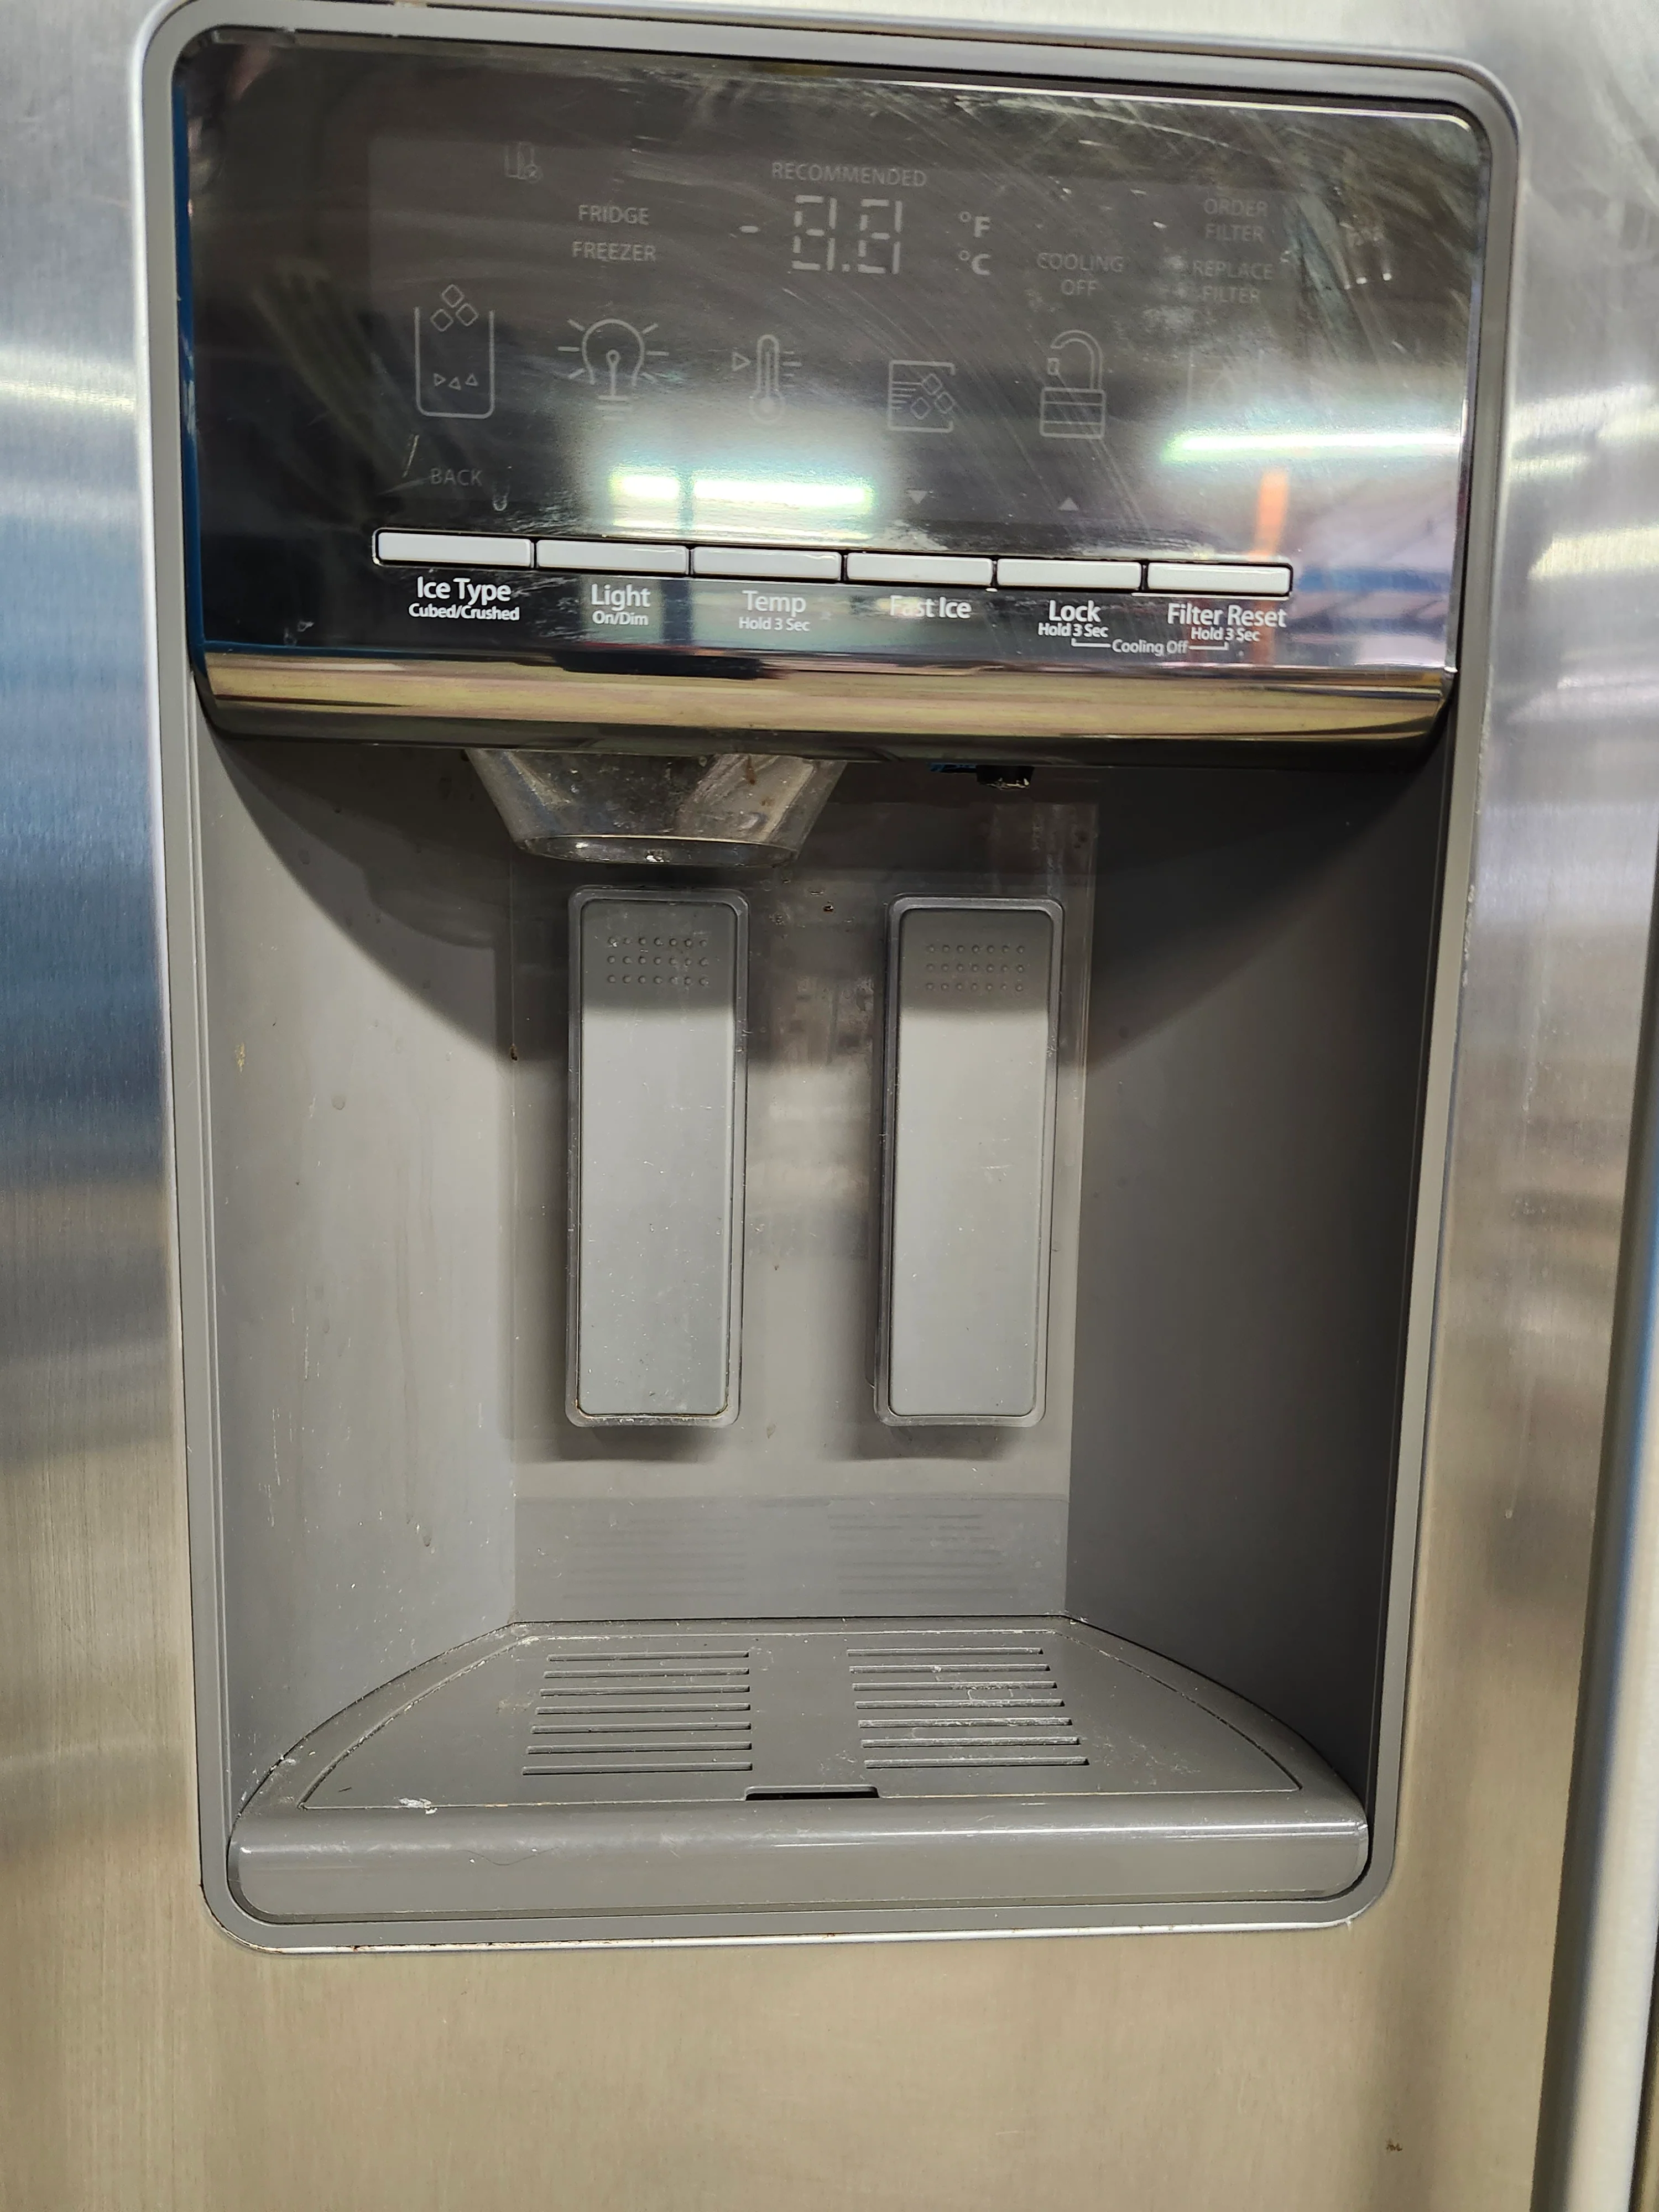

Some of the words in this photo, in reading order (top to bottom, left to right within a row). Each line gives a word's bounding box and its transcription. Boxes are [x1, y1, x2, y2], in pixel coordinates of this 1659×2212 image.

[771, 161, 928, 187] RECOMMENDED
[578, 205, 650, 225] FRIDGE
[1203, 197, 1269, 217] ORDER
[1206, 225, 1264, 242] FILTER
[572, 241, 657, 262] FREEZER
[1036, 253, 1125, 272] COOLING
[1193, 261, 1273, 279] REPLACE
[1061, 280, 1098, 296] OFF
[1203, 287, 1261, 304] FILTER
[430, 468, 482, 486] BACK
[417, 577, 450, 599] Ice
[453, 578, 512, 606] Type
[591, 584, 650, 609] Light
[408, 603, 520, 622] Cubed/Crushed
[742, 590, 806, 616] Temp
[890, 596, 937, 618] Fast
[939, 597, 972, 619] Ice
[1048, 601, 1100, 623] Lock
[592, 610, 649, 627] On/Dim
[738, 615, 771, 630] Hold
[773, 617, 783, 631] 3
[785, 617, 810, 632] Sec
[1167, 604, 1223, 627] Filter
[1228, 606, 1287, 628] Reset
[1037, 622, 1070, 637] Hold
[1071, 623, 1081, 637] 3
[1083, 624, 1109, 638] Sec
[1191, 627, 1223, 641] Hold
[1225, 628, 1234, 641] 3
[1236, 628, 1260, 643] Sec
[1112, 638, 1165, 657] Cooling
[1166, 639, 1188, 655] Off
